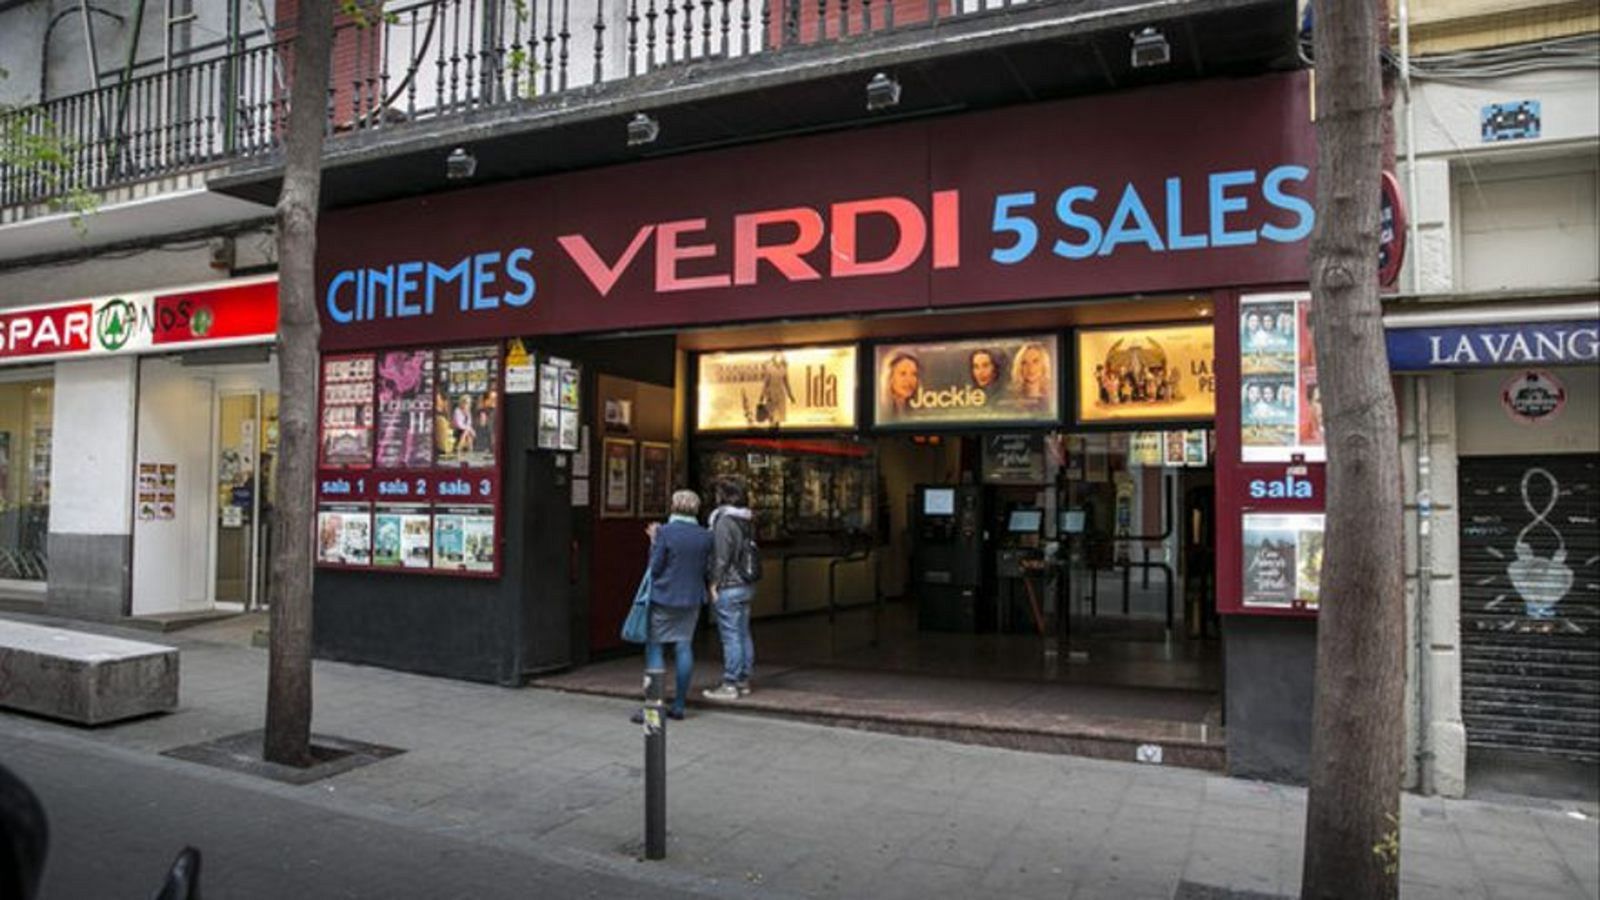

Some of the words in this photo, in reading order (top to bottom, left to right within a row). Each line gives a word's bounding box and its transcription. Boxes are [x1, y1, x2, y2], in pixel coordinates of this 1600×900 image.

[326, 247, 536, 323] CINEMES
[557, 189, 960, 297] VERDI
[991, 191, 1039, 264] 5
[1053, 165, 1316, 258] SALES
[805, 363, 838, 408] Ida
[909, 384, 987, 409] Jackie
[321, 478, 350, 494] sala
[356, 478, 365, 494] 1
[378, 478, 409, 495] sala
[416, 478, 427, 495] 2
[438, 478, 471, 495] sala
[480, 480, 492, 495] 3
[1250, 475, 1313, 498] sala
